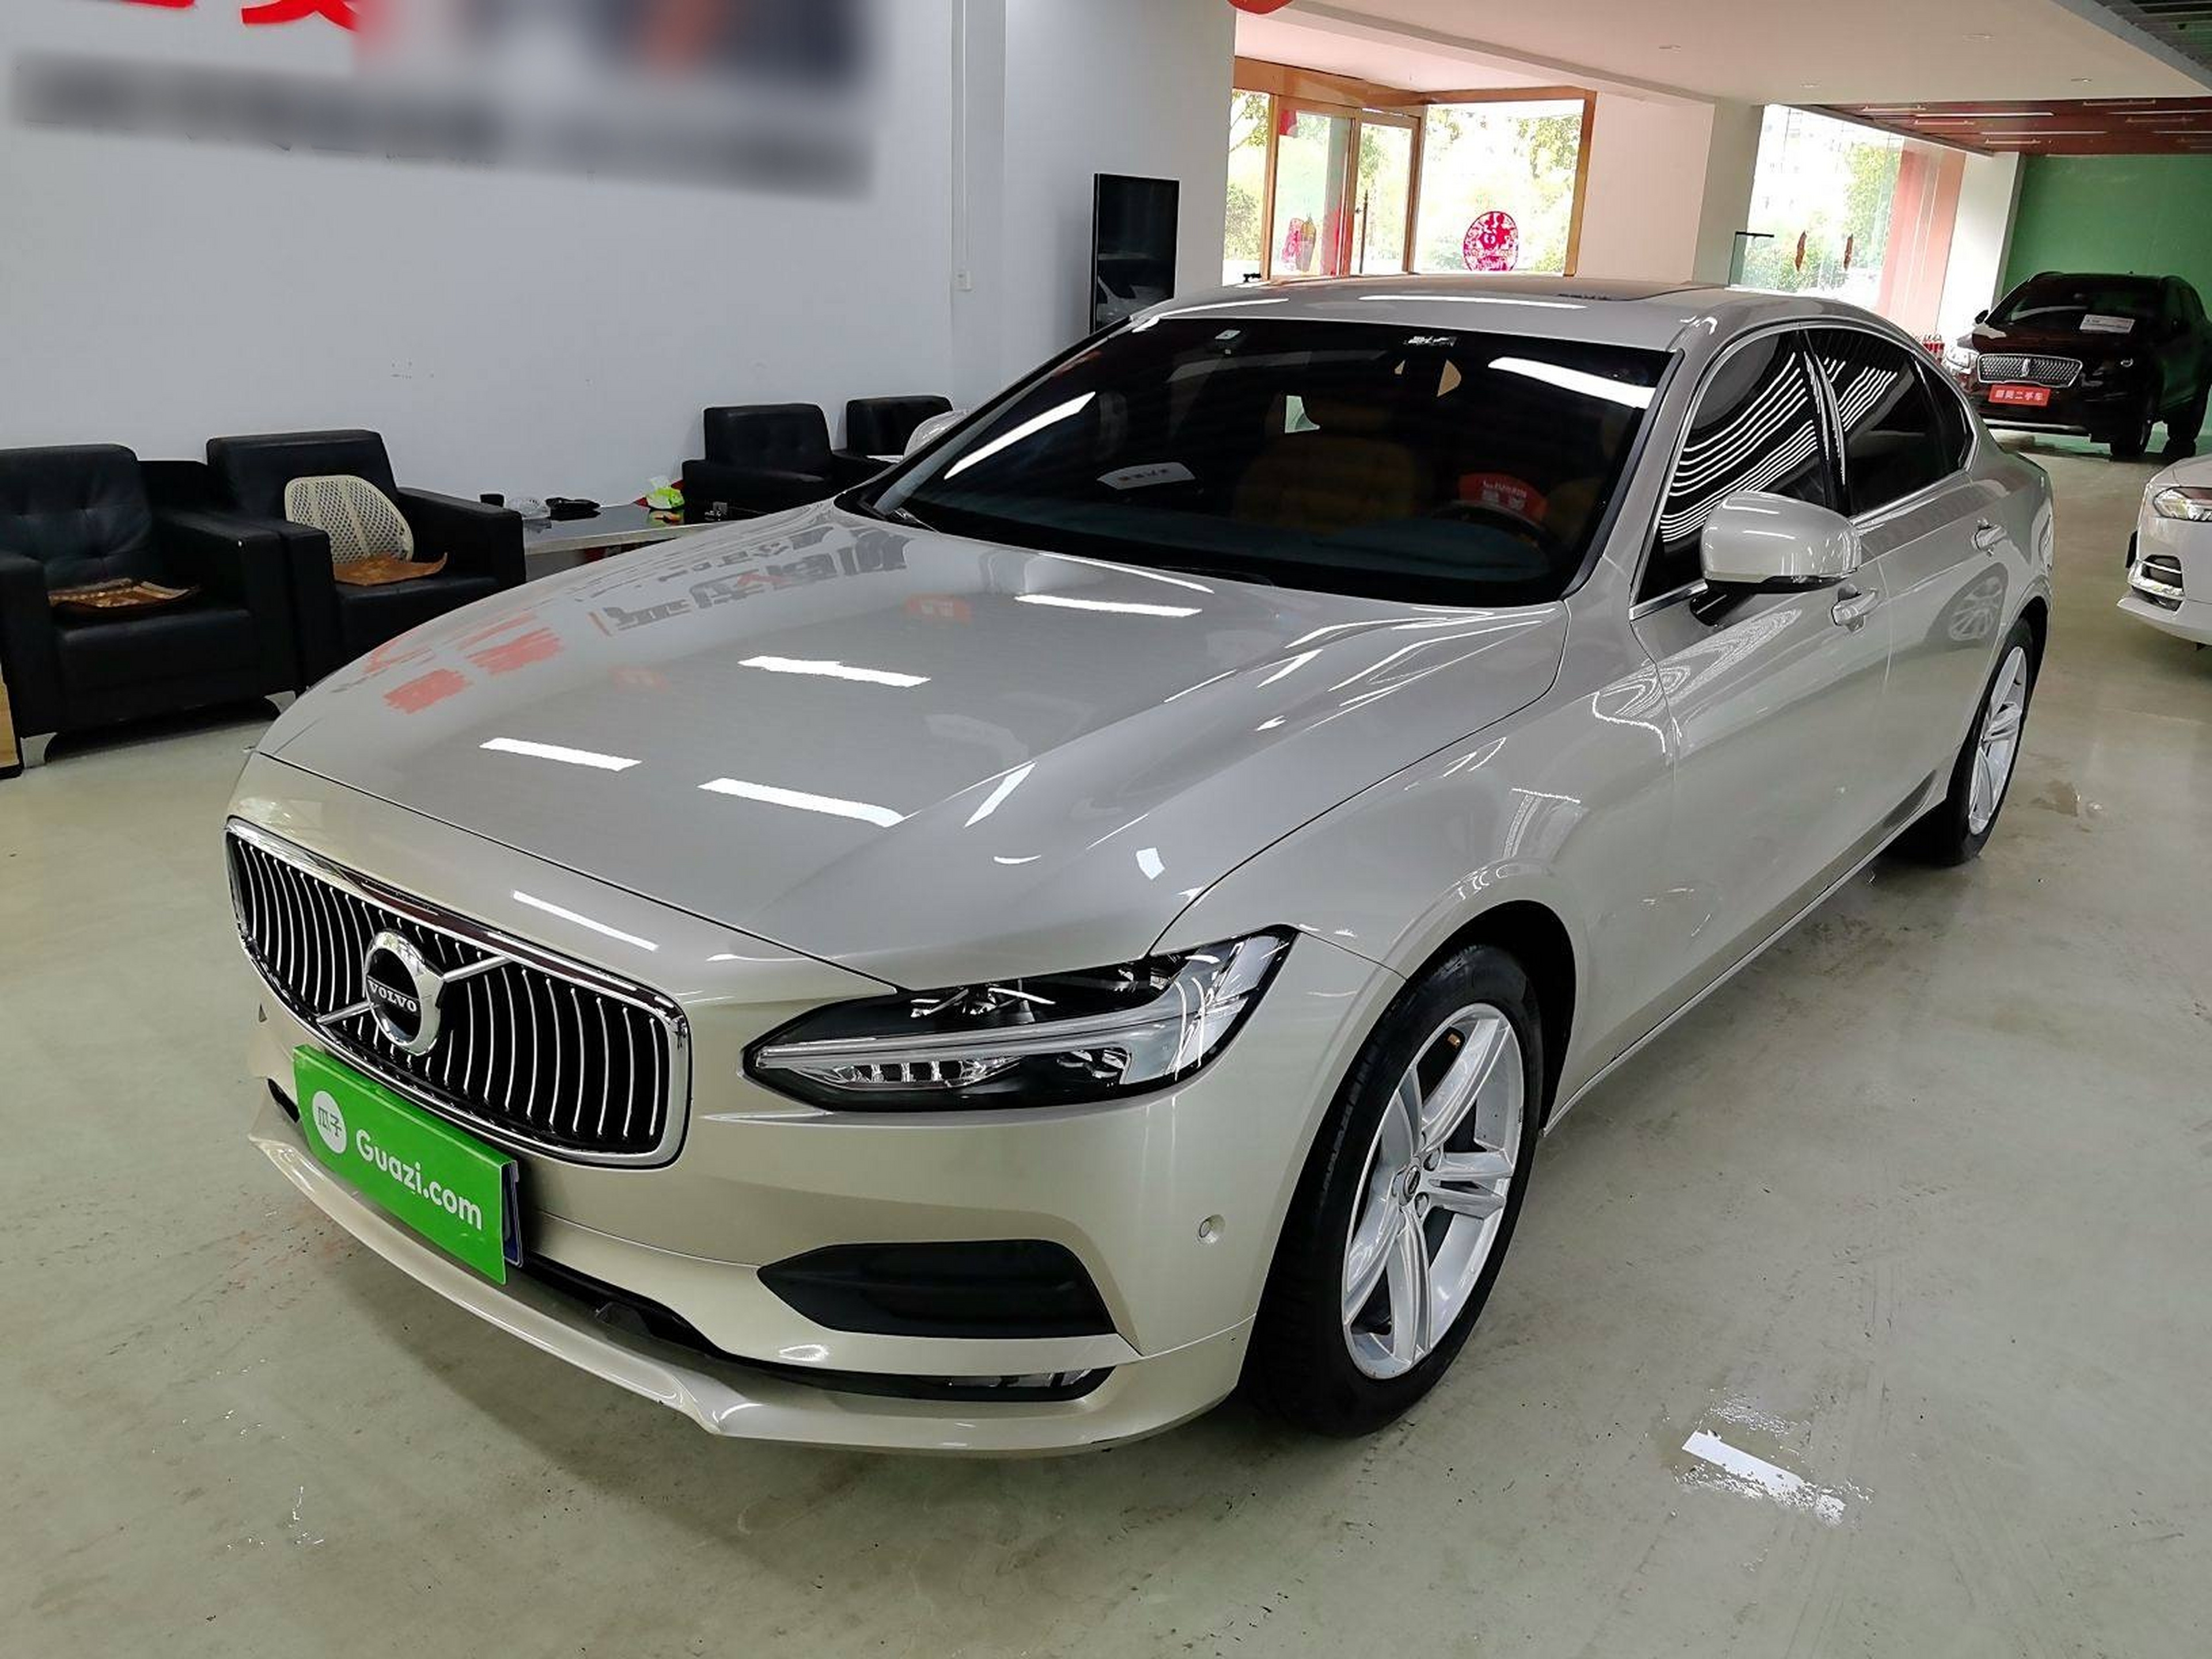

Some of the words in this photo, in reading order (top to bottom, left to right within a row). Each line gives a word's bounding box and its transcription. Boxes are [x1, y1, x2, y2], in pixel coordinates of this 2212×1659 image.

[368, 979, 416, 1012] VOLVO
[317, 1106, 342, 1138] 瓜子
[355, 1129, 482, 1230] Guazi.com
